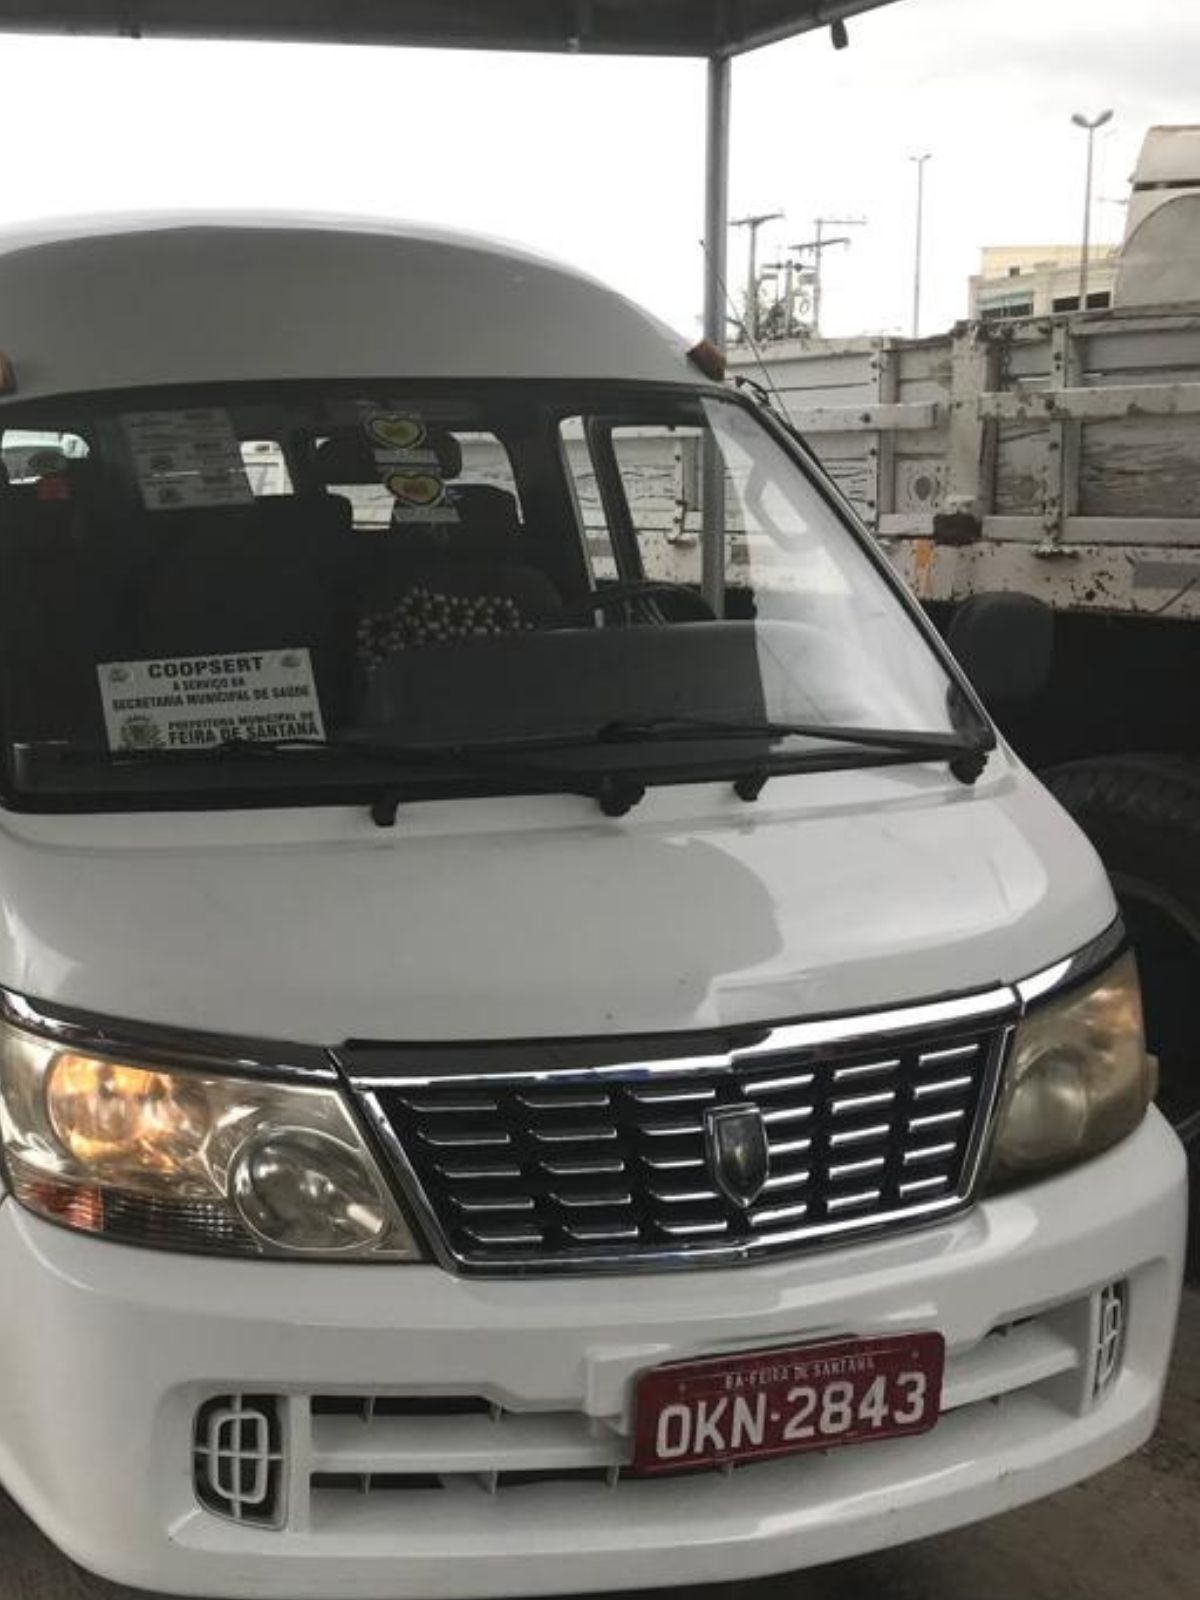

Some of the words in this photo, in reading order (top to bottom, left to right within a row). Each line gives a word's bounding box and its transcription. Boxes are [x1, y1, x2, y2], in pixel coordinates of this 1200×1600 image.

[148, 656, 263, 678] COOPSERT
[183, 677, 229, 690] SERVIÇO
[112, 695, 184, 711] SECRETARIA
[187, 691, 249, 705] MUNICIPAL
[253, 688, 269, 701] DE
[168, 717, 236, 730] PREFEITURA
[238, 713, 297, 725] MUNICIPAL
[300, 711, 314, 722] DE
[168, 729, 216, 745] FEIRA
[220, 726, 241, 741] DE
[247, 721, 320, 740] SANTANA
[793, 1363, 810, 1381] DE
[813, 1356, 876, 1377] SANTANA
